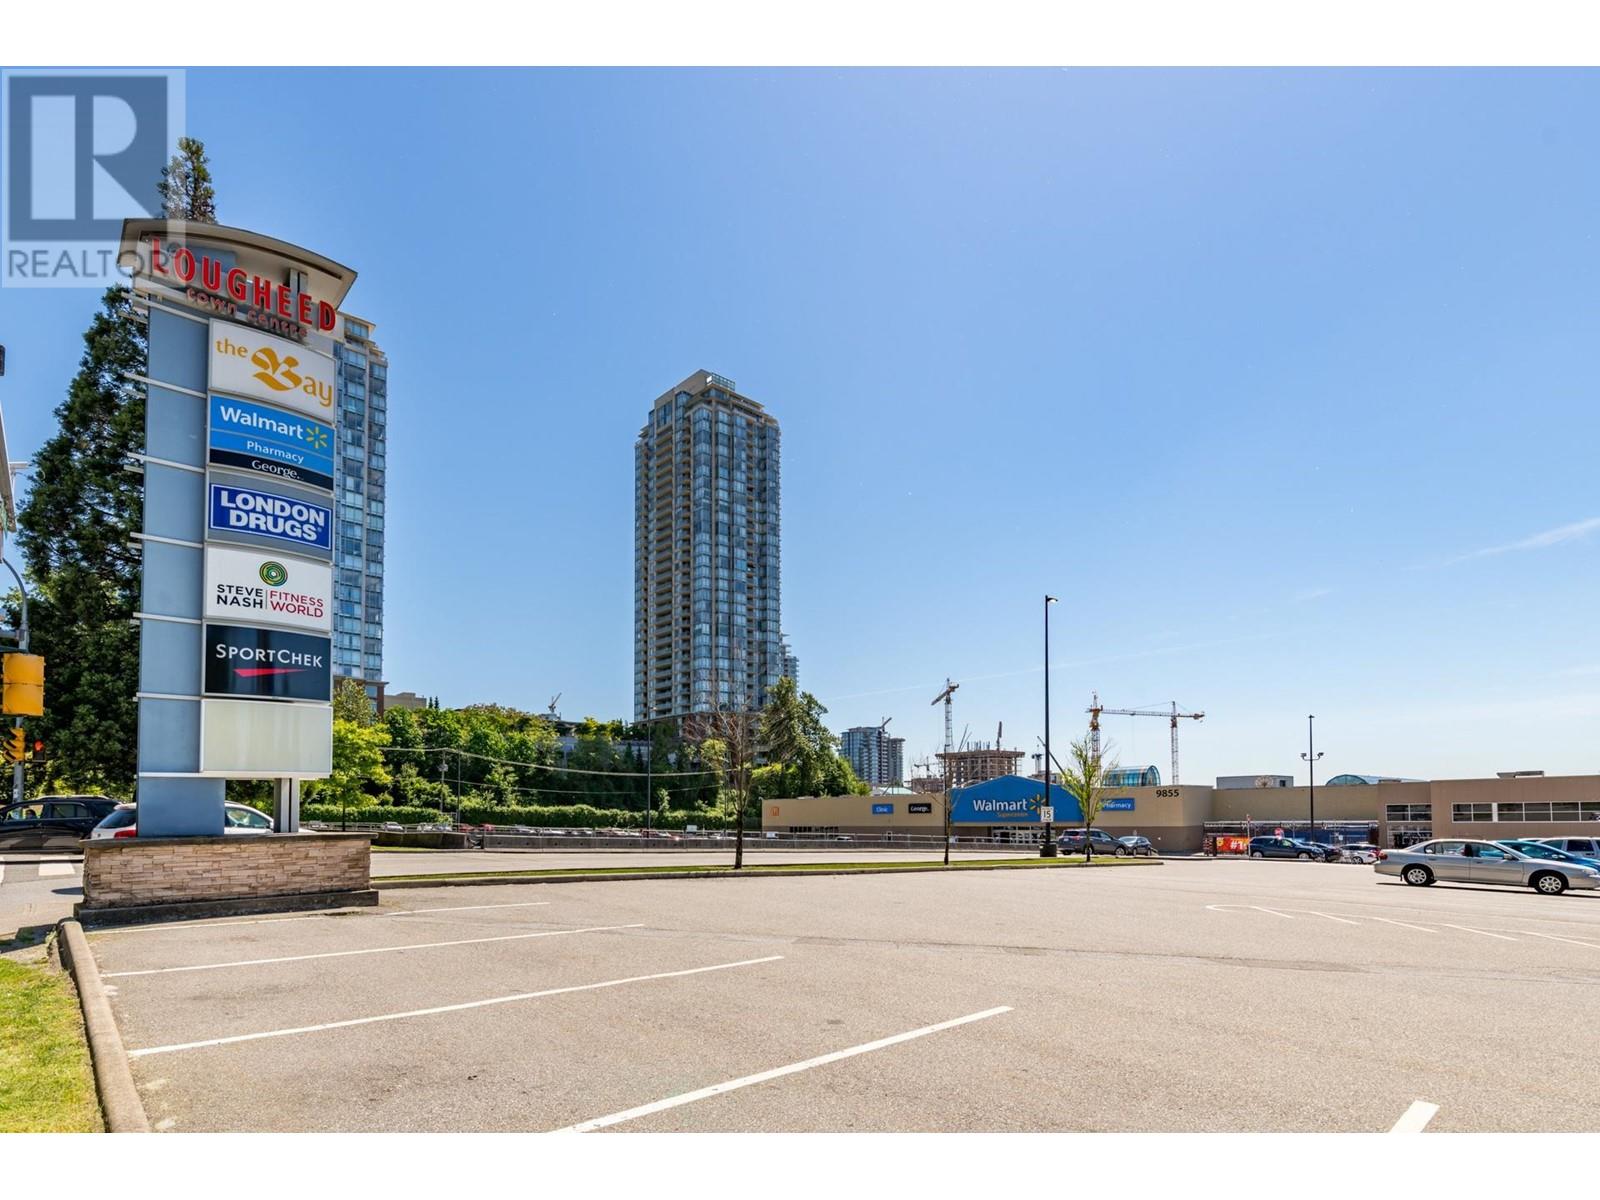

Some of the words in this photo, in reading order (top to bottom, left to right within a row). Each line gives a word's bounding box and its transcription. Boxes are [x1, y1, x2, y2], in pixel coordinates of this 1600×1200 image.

[151, 236, 337, 333] LOUGHEED
[215, 337, 249, 358] the
[220, 405, 304, 440] Walmart
[247, 440, 304, 465] Pharmacy
[220, 490, 325, 527] LONDON
[229, 509, 318, 541] DRUGS
[216, 583, 263, 597] STEVE
[269, 590, 324, 607] FITNESS
[216, 595, 263, 609] NASH
[269, 601, 324, 618] WORLD
[1155, 788, 1180, 798] 9855
[972, 798, 1028, 812] Walmart
[1043, 810, 1053, 819] 15
